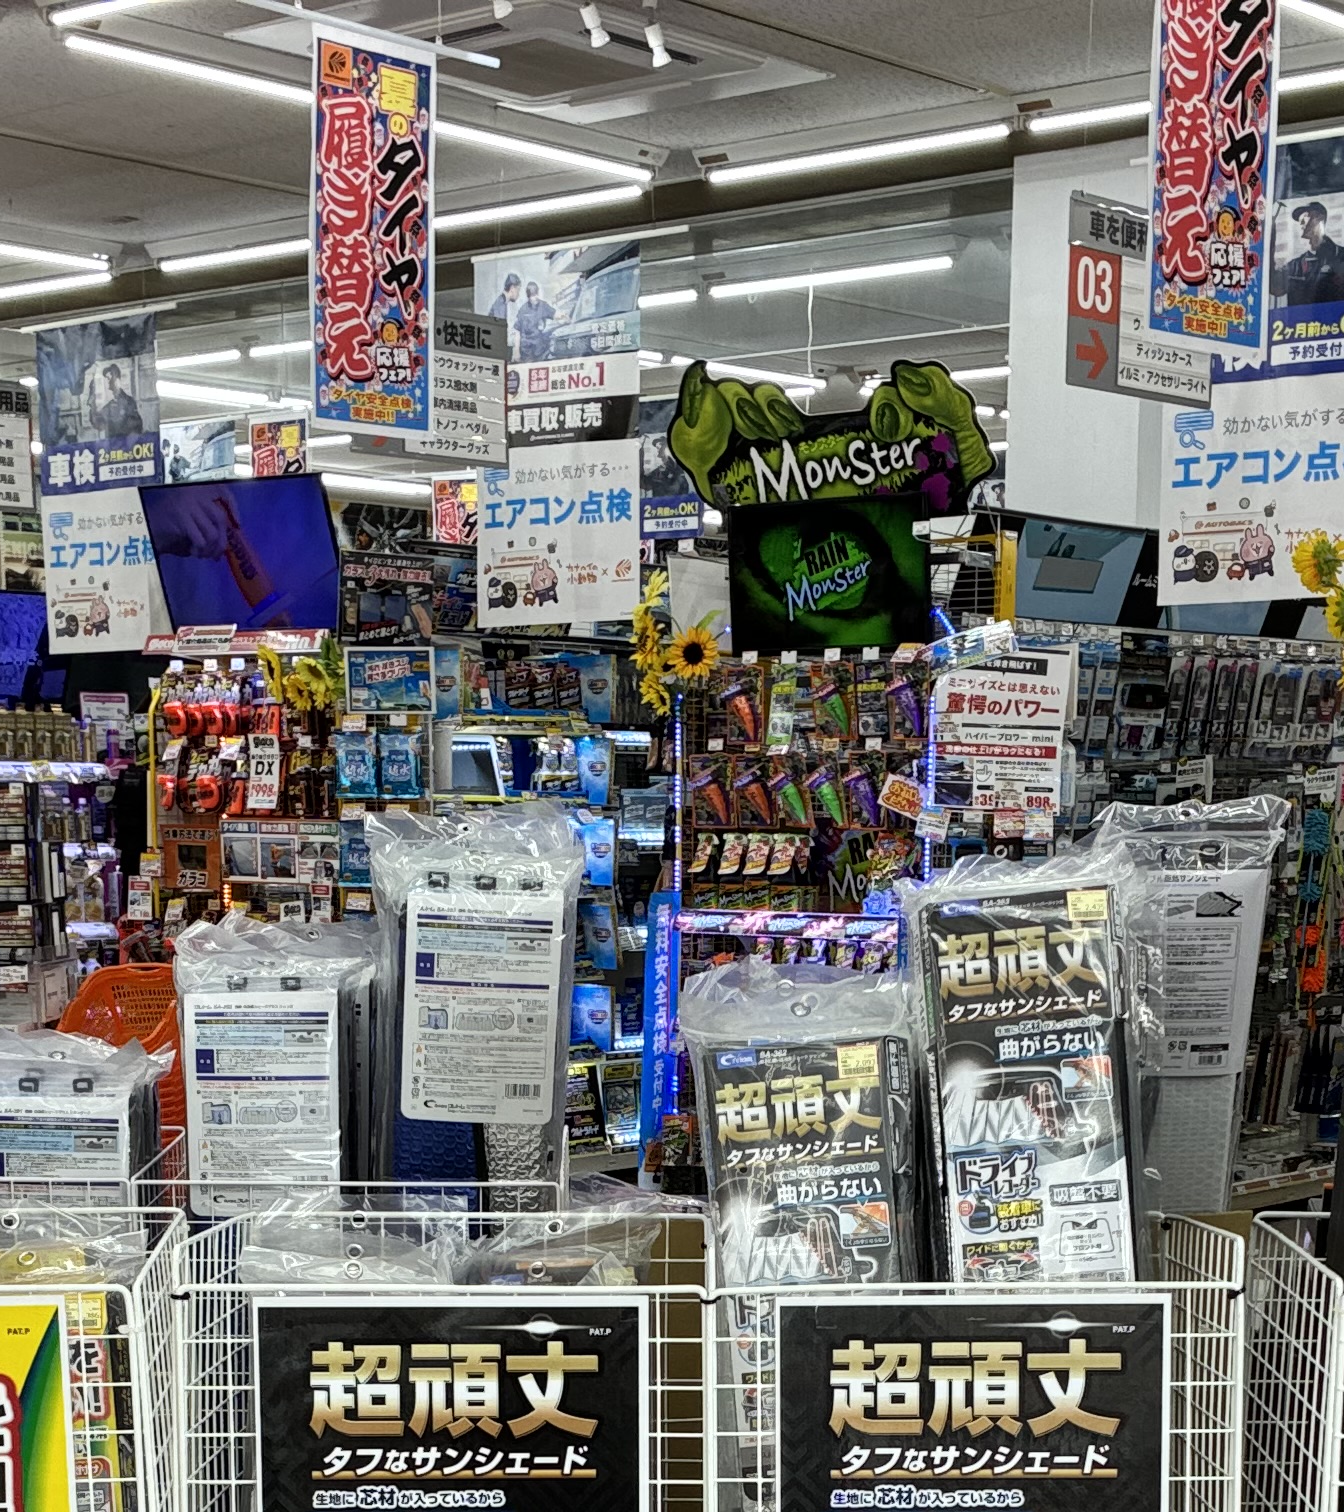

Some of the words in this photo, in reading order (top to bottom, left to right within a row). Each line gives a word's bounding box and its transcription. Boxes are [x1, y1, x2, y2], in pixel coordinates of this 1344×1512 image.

[1077, 256, 1113, 312] 03
[1165, 292, 1245, 322] タイヤ安全点検
[1136, 345, 1193, 368] ティッシュケース
[551, 378, 566, 390] 総合
[568, 362, 605, 389] No.1
[333, 386, 413, 411] タイヤ安全点検
[48, 446, 95, 488] 車検
[483, 488, 632, 529] エアコン点検
[804, 535, 849, 573] RAIN
[947, 692, 1060, 718] 驚愕のパワー
[1032, 735, 1053, 743] mini
[255, 761, 275, 776] DX
[939, 923, 1104, 998] 超頑丈
[948, 989, 1103, 1021] タフなサンシェード
[999, 1032, 1106, 1061] 曲がらない
[715, 1075, 883, 1145] 超頑丈
[310, 1341, 599, 1439] 超頑丈
[829, 1339, 1122, 1438] 超頑丈
[323, 1446, 590, 1475] タフなサンシェード
